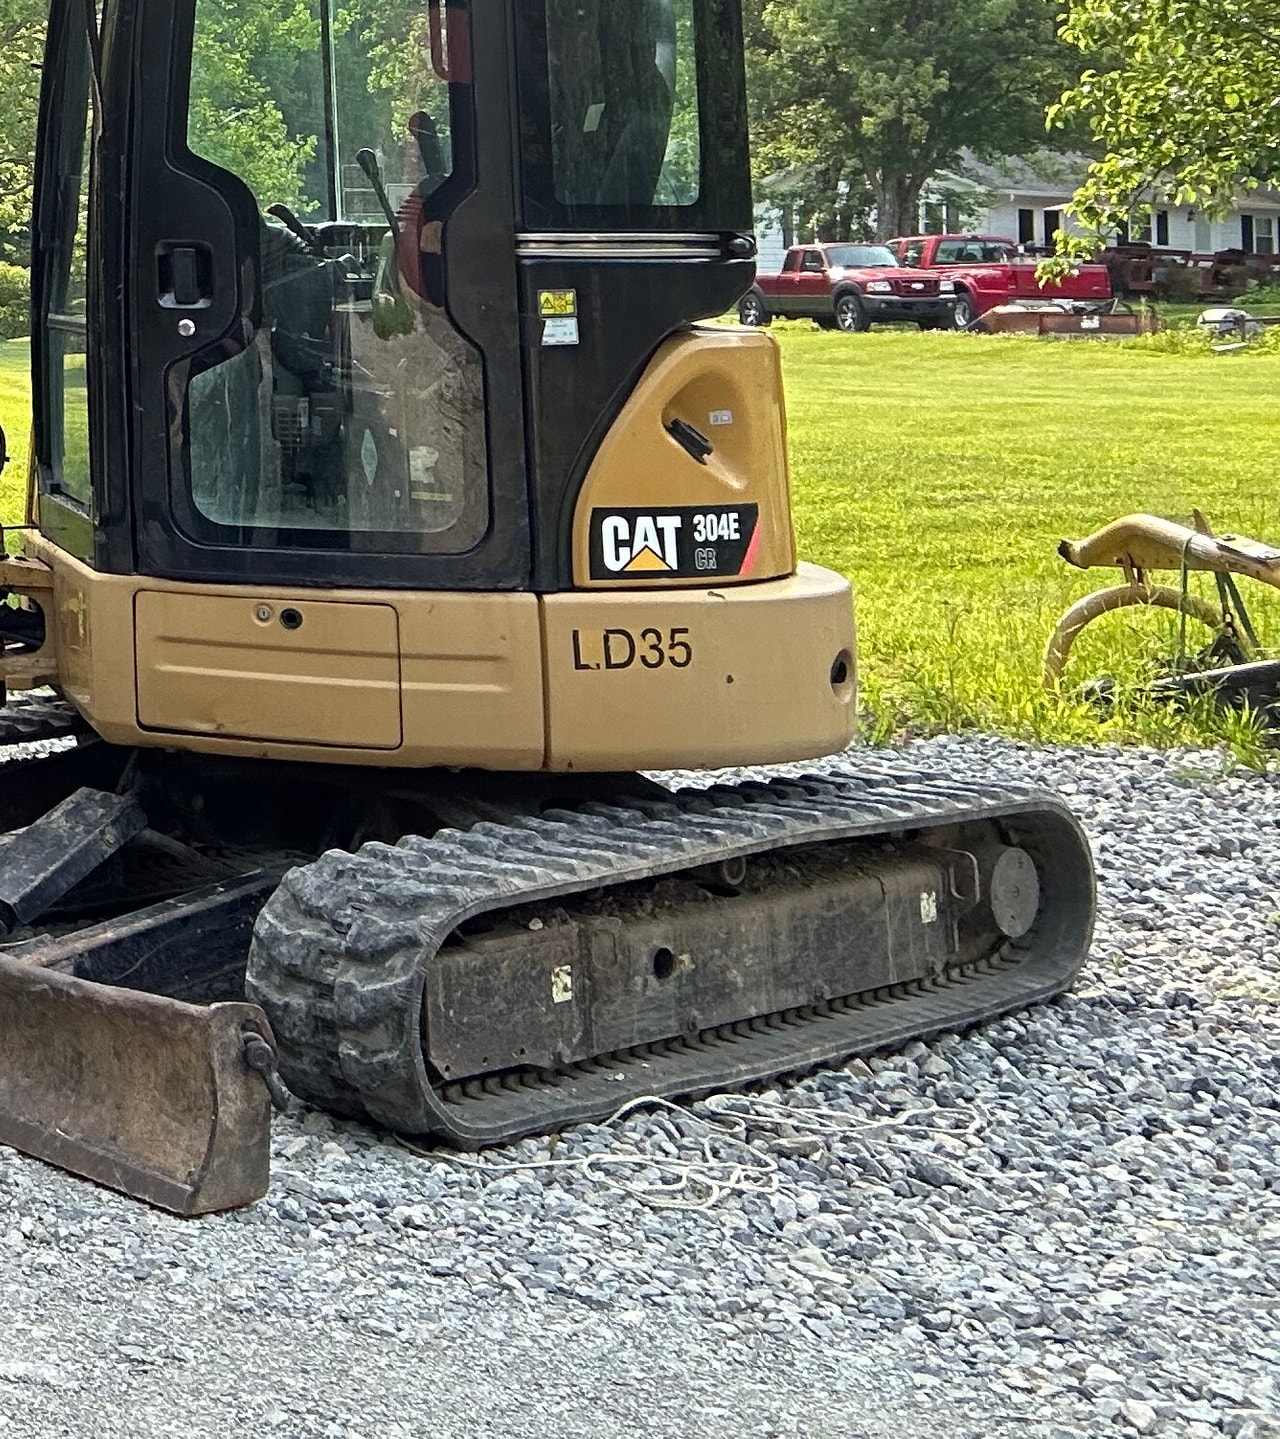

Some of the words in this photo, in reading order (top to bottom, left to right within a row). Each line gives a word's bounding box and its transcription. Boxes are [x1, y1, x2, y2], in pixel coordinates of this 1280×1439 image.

[601, 515, 682, 572] CAT
[692, 512, 741, 543] 304E
[694, 547, 718, 571] CR
[571, 627, 693, 671] LD35
